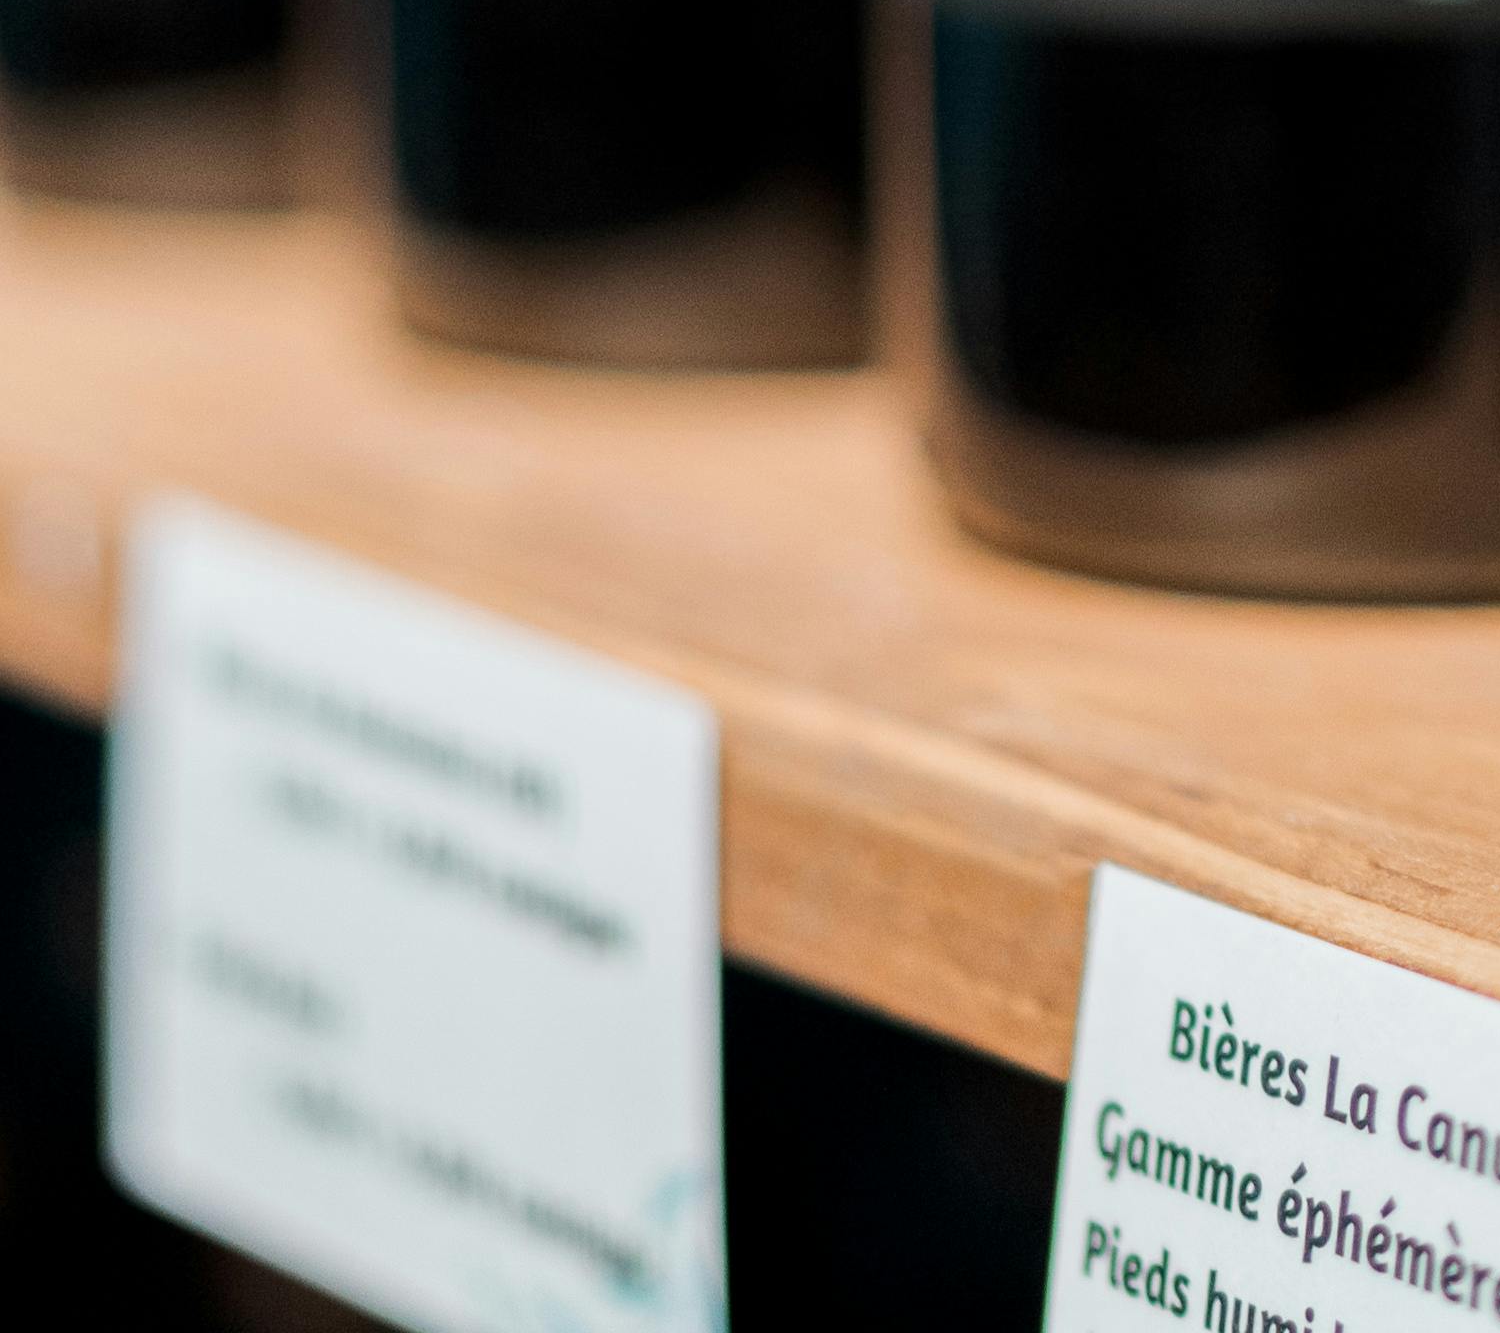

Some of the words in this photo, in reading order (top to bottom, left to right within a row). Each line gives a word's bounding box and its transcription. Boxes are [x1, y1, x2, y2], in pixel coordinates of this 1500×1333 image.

[1167, 997, 1310, 1108] Bières
[1322, 1053, 1380, 1135] La
[1096, 1100, 1264, 1223] Gamme
[1083, 1221, 1191, 1320] Pieds
